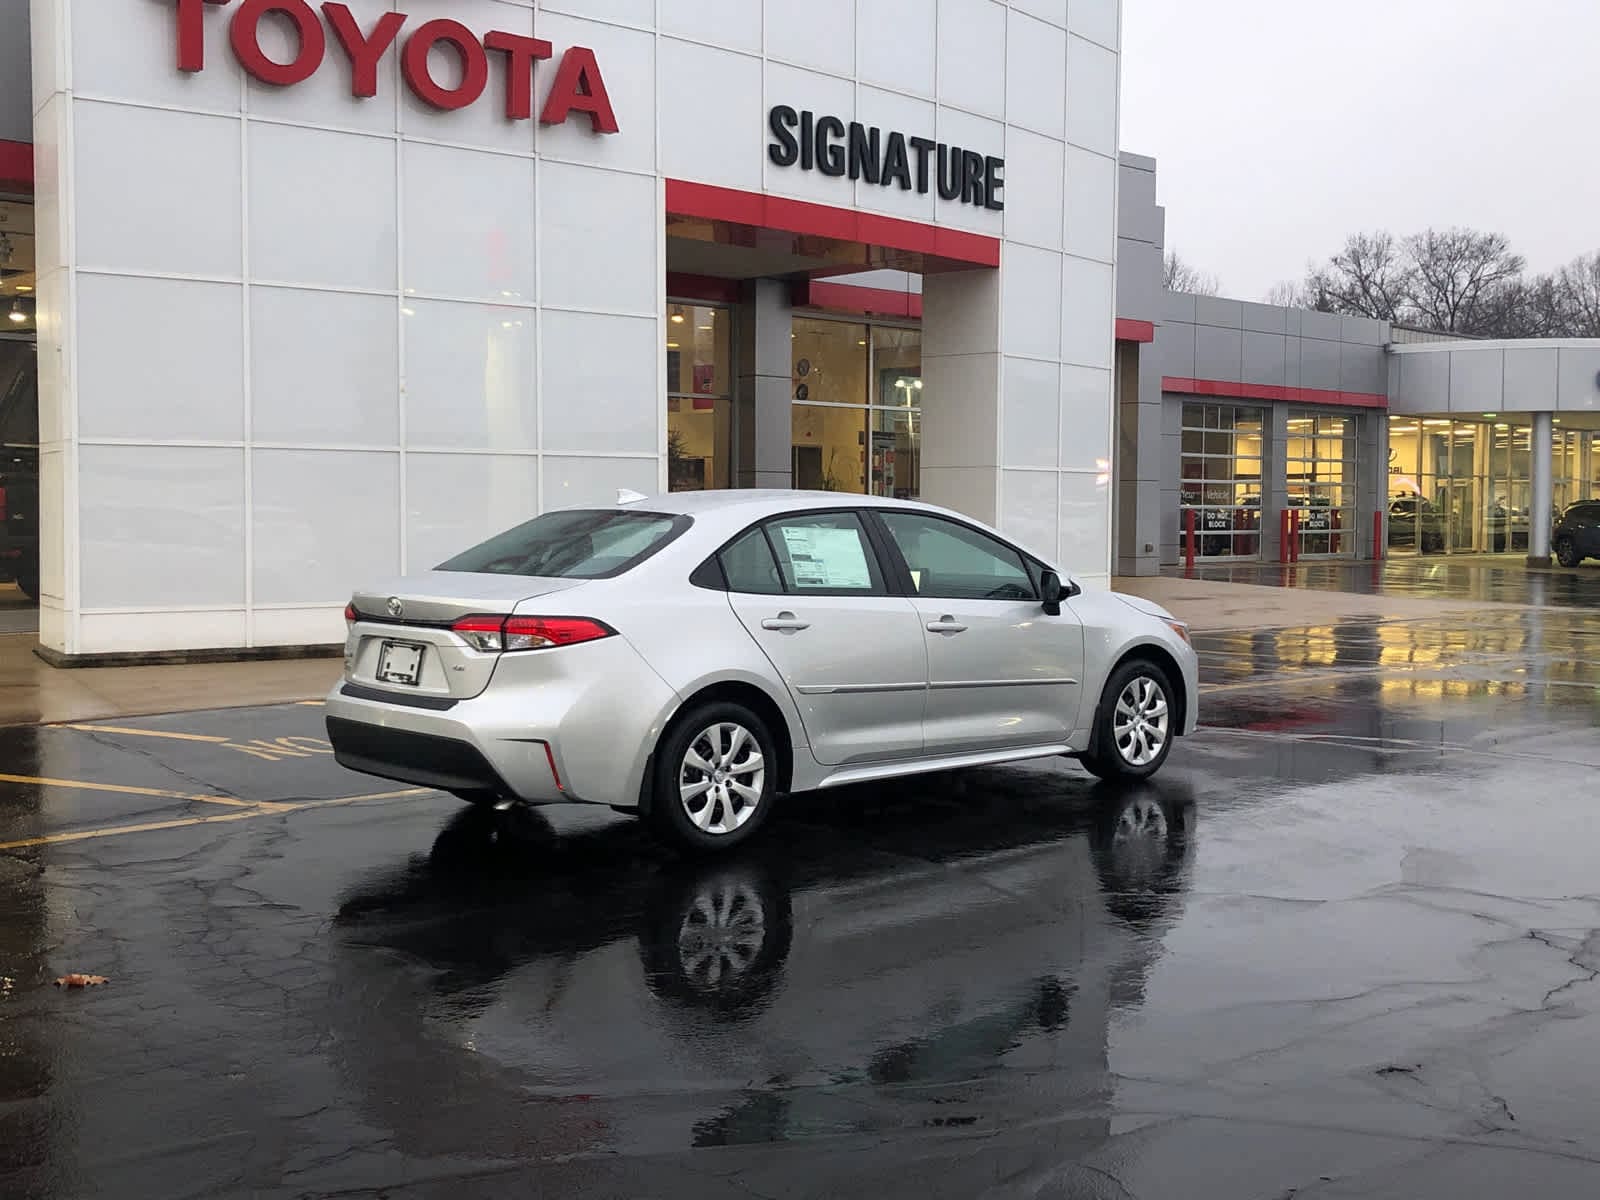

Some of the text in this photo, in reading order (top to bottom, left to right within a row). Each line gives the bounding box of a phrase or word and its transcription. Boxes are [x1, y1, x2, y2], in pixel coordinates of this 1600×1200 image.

[170, 0, 619, 134] TOYOTA
[768, 105, 1005, 211] SIGNATURE
[1207, 512, 1215, 520] DO
